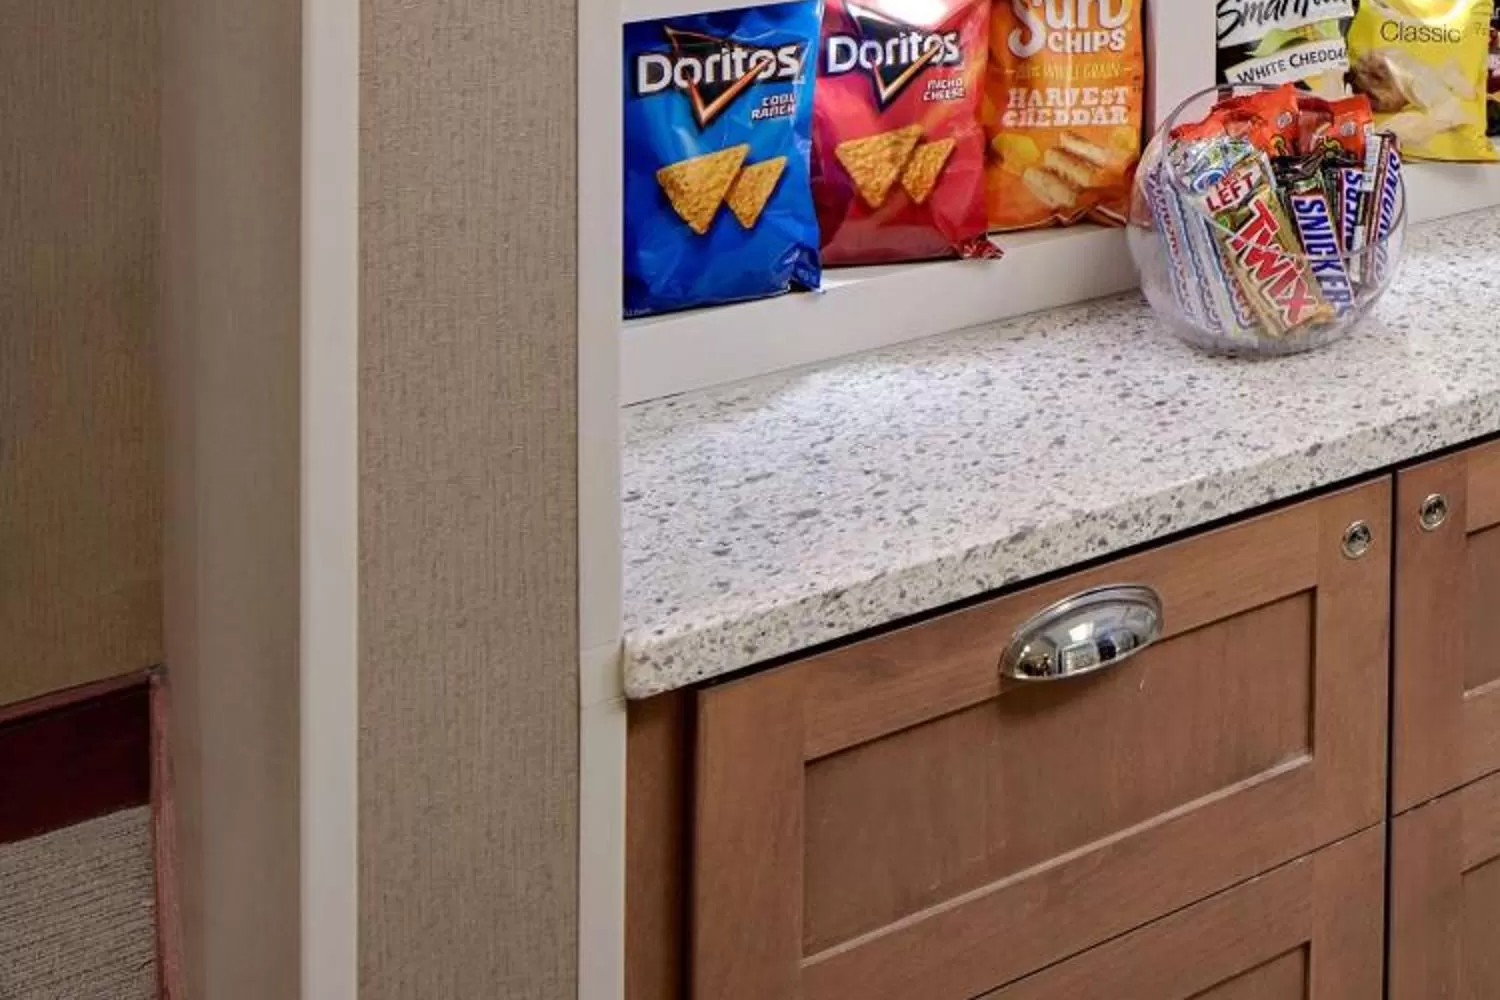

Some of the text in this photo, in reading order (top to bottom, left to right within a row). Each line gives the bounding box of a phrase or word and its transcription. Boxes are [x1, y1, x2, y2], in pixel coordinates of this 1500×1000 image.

[1048, 29, 1126, 53] CHIPS
[1380, 19, 1461, 43] Classic
[827, 30, 962, 74] Doritos
[638, 46, 798, 94] Doritos
[1236, 60, 1286, 83] WHITE
[923, 88, 964, 102] CHEESE
[1007, 87, 1129, 109] HARVEST
[1002, 105, 1129, 128] CHEDDAR
[1206, 170, 1254, 213] LEFT
[1230, 199, 1312, 326] TWIX
